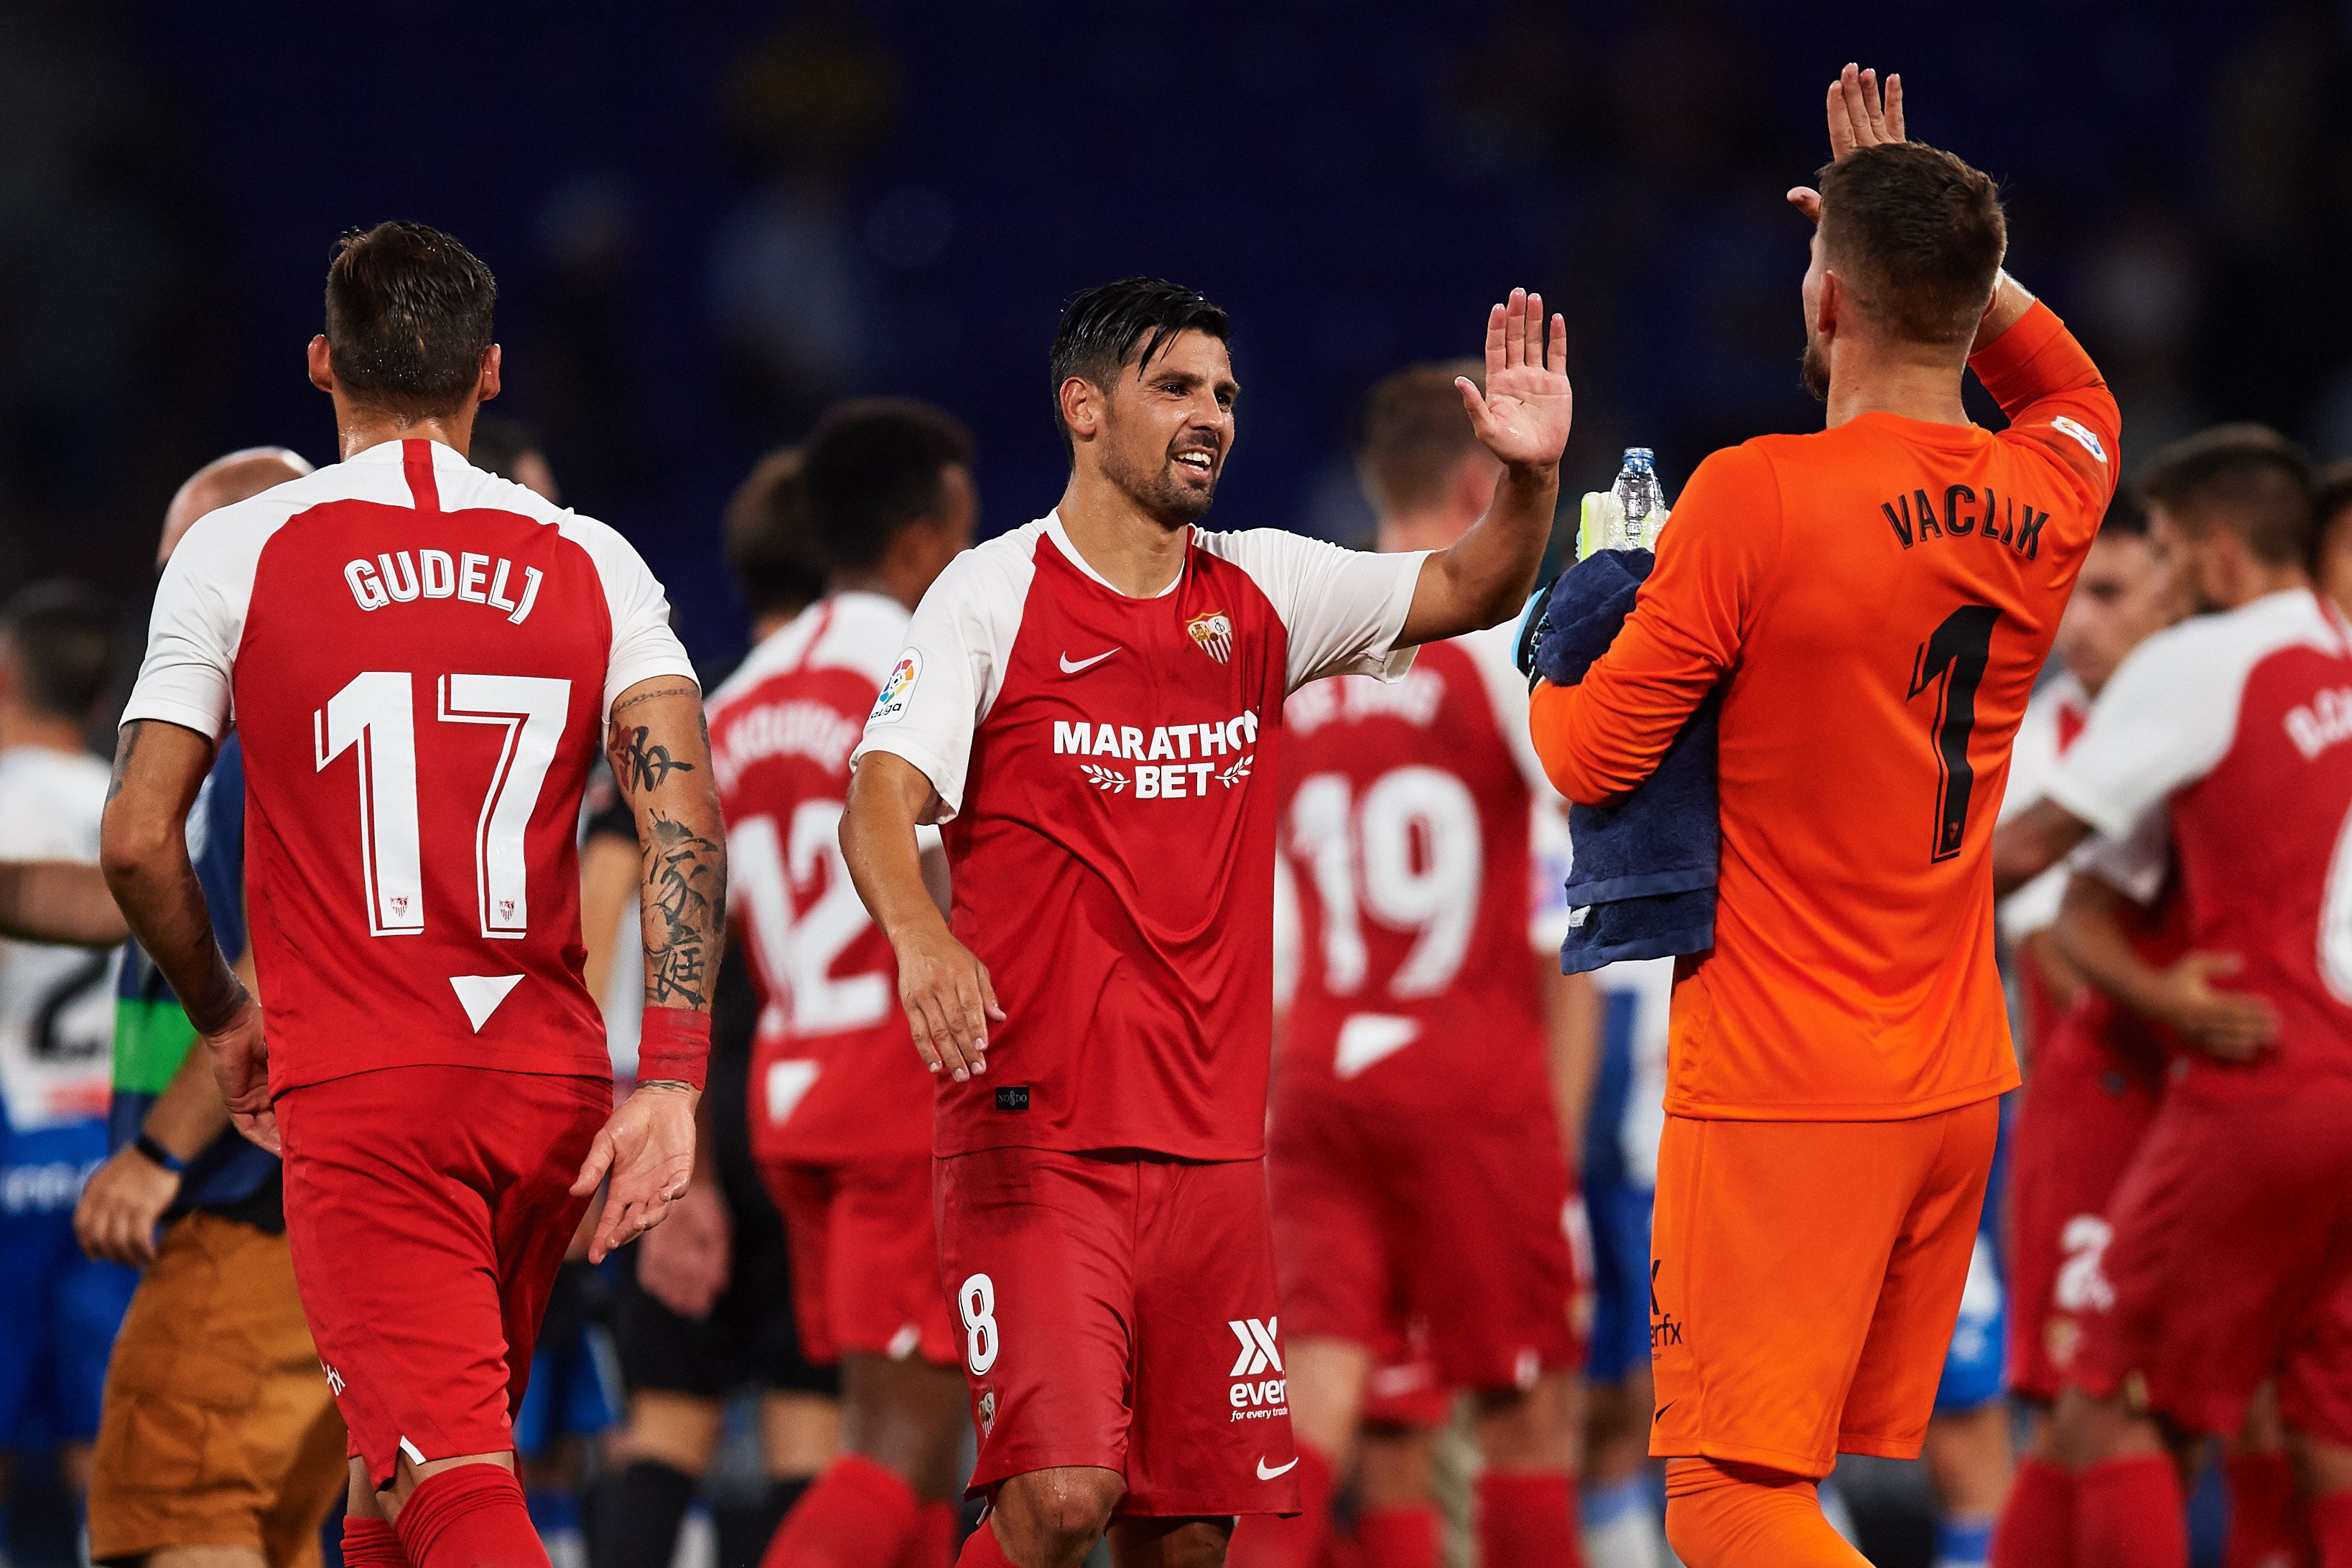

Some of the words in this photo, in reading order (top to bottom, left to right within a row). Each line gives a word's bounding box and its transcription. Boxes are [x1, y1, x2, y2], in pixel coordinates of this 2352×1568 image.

[1881, 484, 2050, 559] VACLIK
[343, 549, 544, 625] GUDELJ
[1135, 762, 1215, 799] BET
[1906, 605, 2004, 864] 1
[314, 671, 572, 939] 17
[727, 798, 893, 1040] 12
[1289, 765, 1485, 999] 19
[959, 1273, 999, 1376] 8
[1230, 1410, 1245, 1422] for
[1246, 1408, 1271, 1419] every
